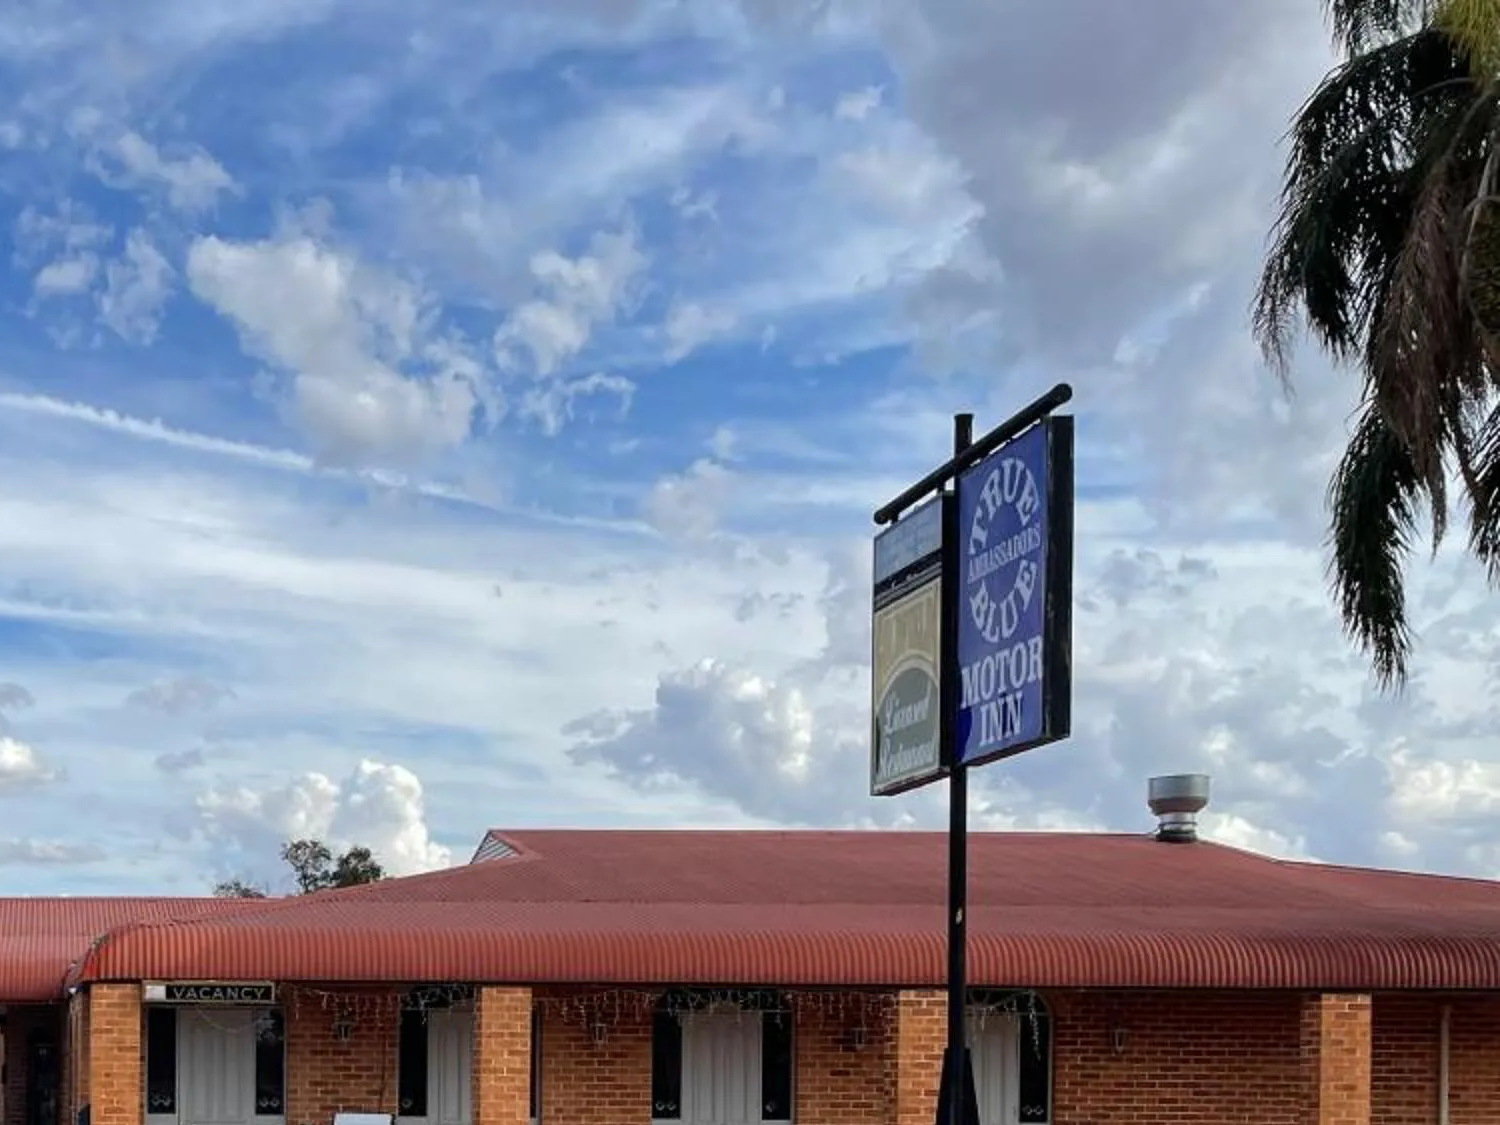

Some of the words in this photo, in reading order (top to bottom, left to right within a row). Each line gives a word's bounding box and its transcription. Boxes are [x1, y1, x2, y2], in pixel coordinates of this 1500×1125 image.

[969, 457, 1039, 555] TRUE
[969, 559, 1037, 643] BLUE
[960, 635, 1042, 709] MOTOR
[979, 691, 1023, 747] INN
[173, 987, 265, 1000] VACANCY
